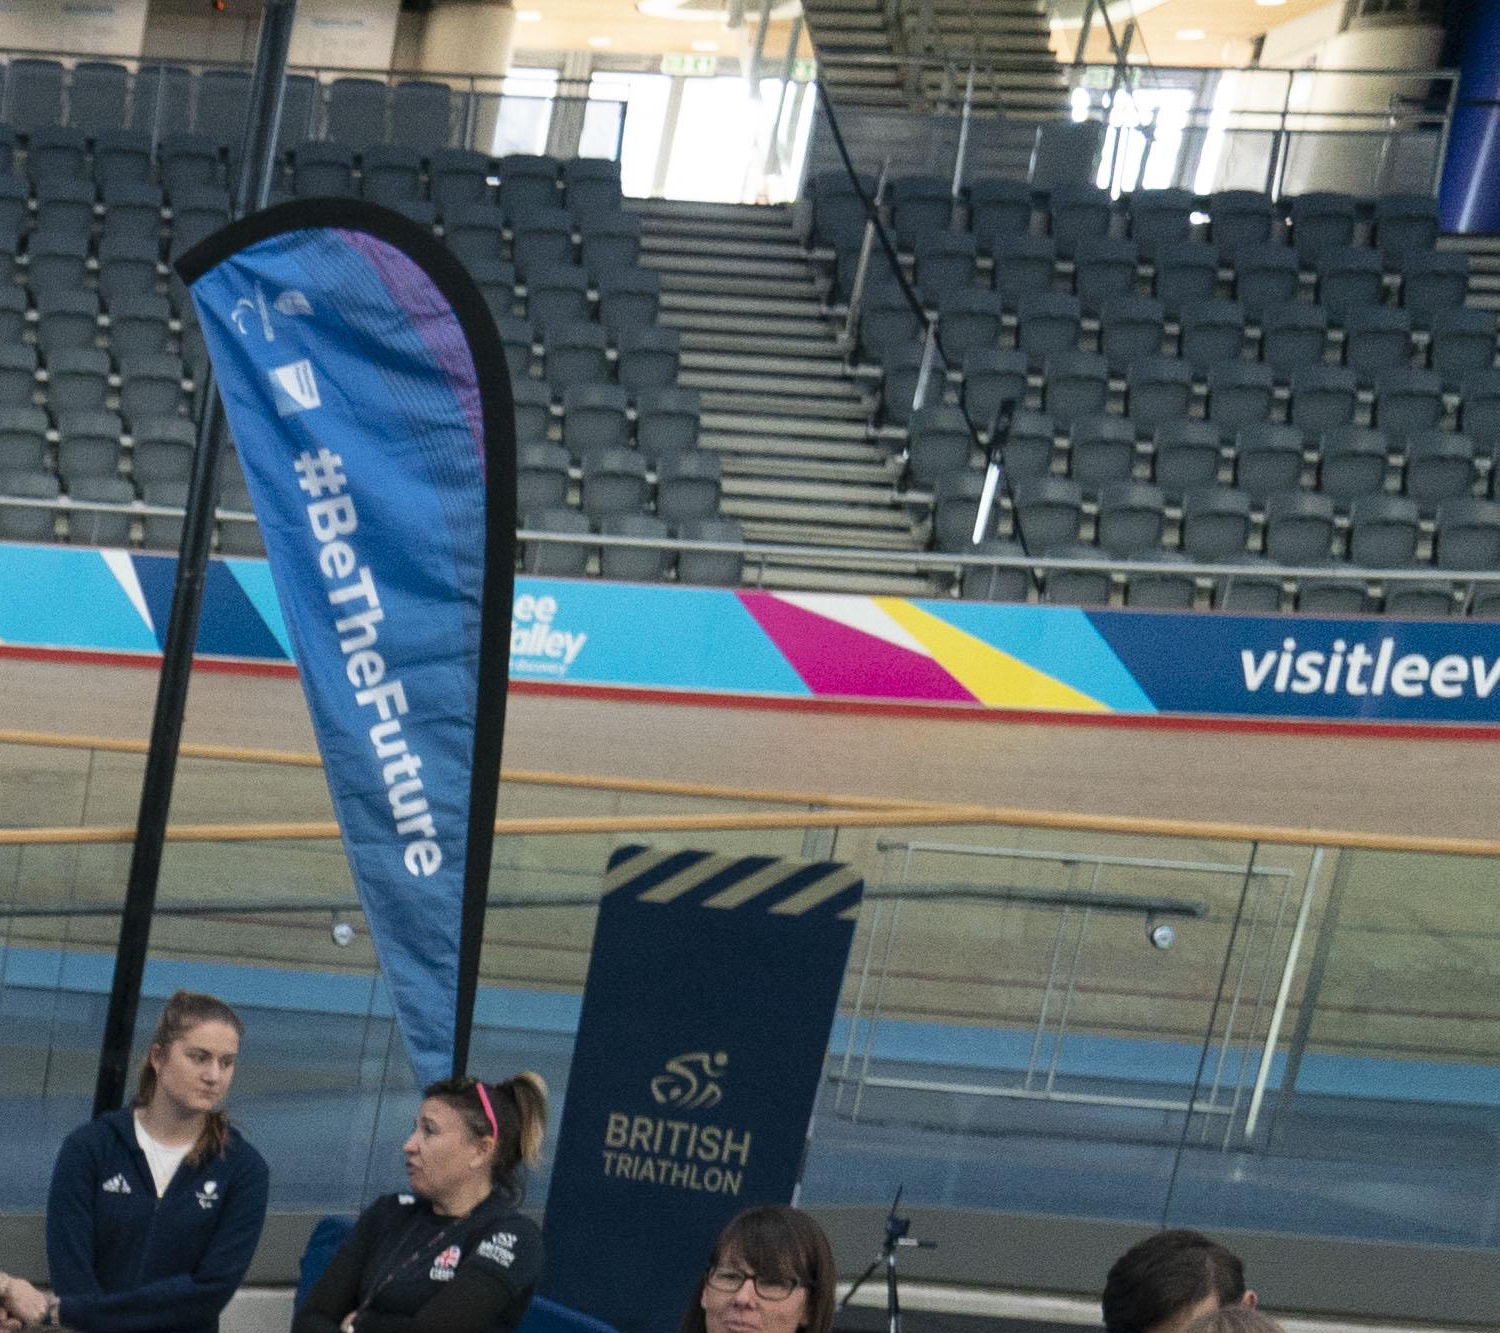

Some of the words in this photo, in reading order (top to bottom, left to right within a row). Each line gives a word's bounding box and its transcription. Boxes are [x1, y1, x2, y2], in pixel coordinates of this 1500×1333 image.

[513, 594, 557, 623] ee
[293, 447, 443, 878] #BeTheFuture
[509, 621, 588, 664] alley
[603, 1111, 752, 1167] BRITISH
[602, 1151, 744, 1197] TRIATHLON
